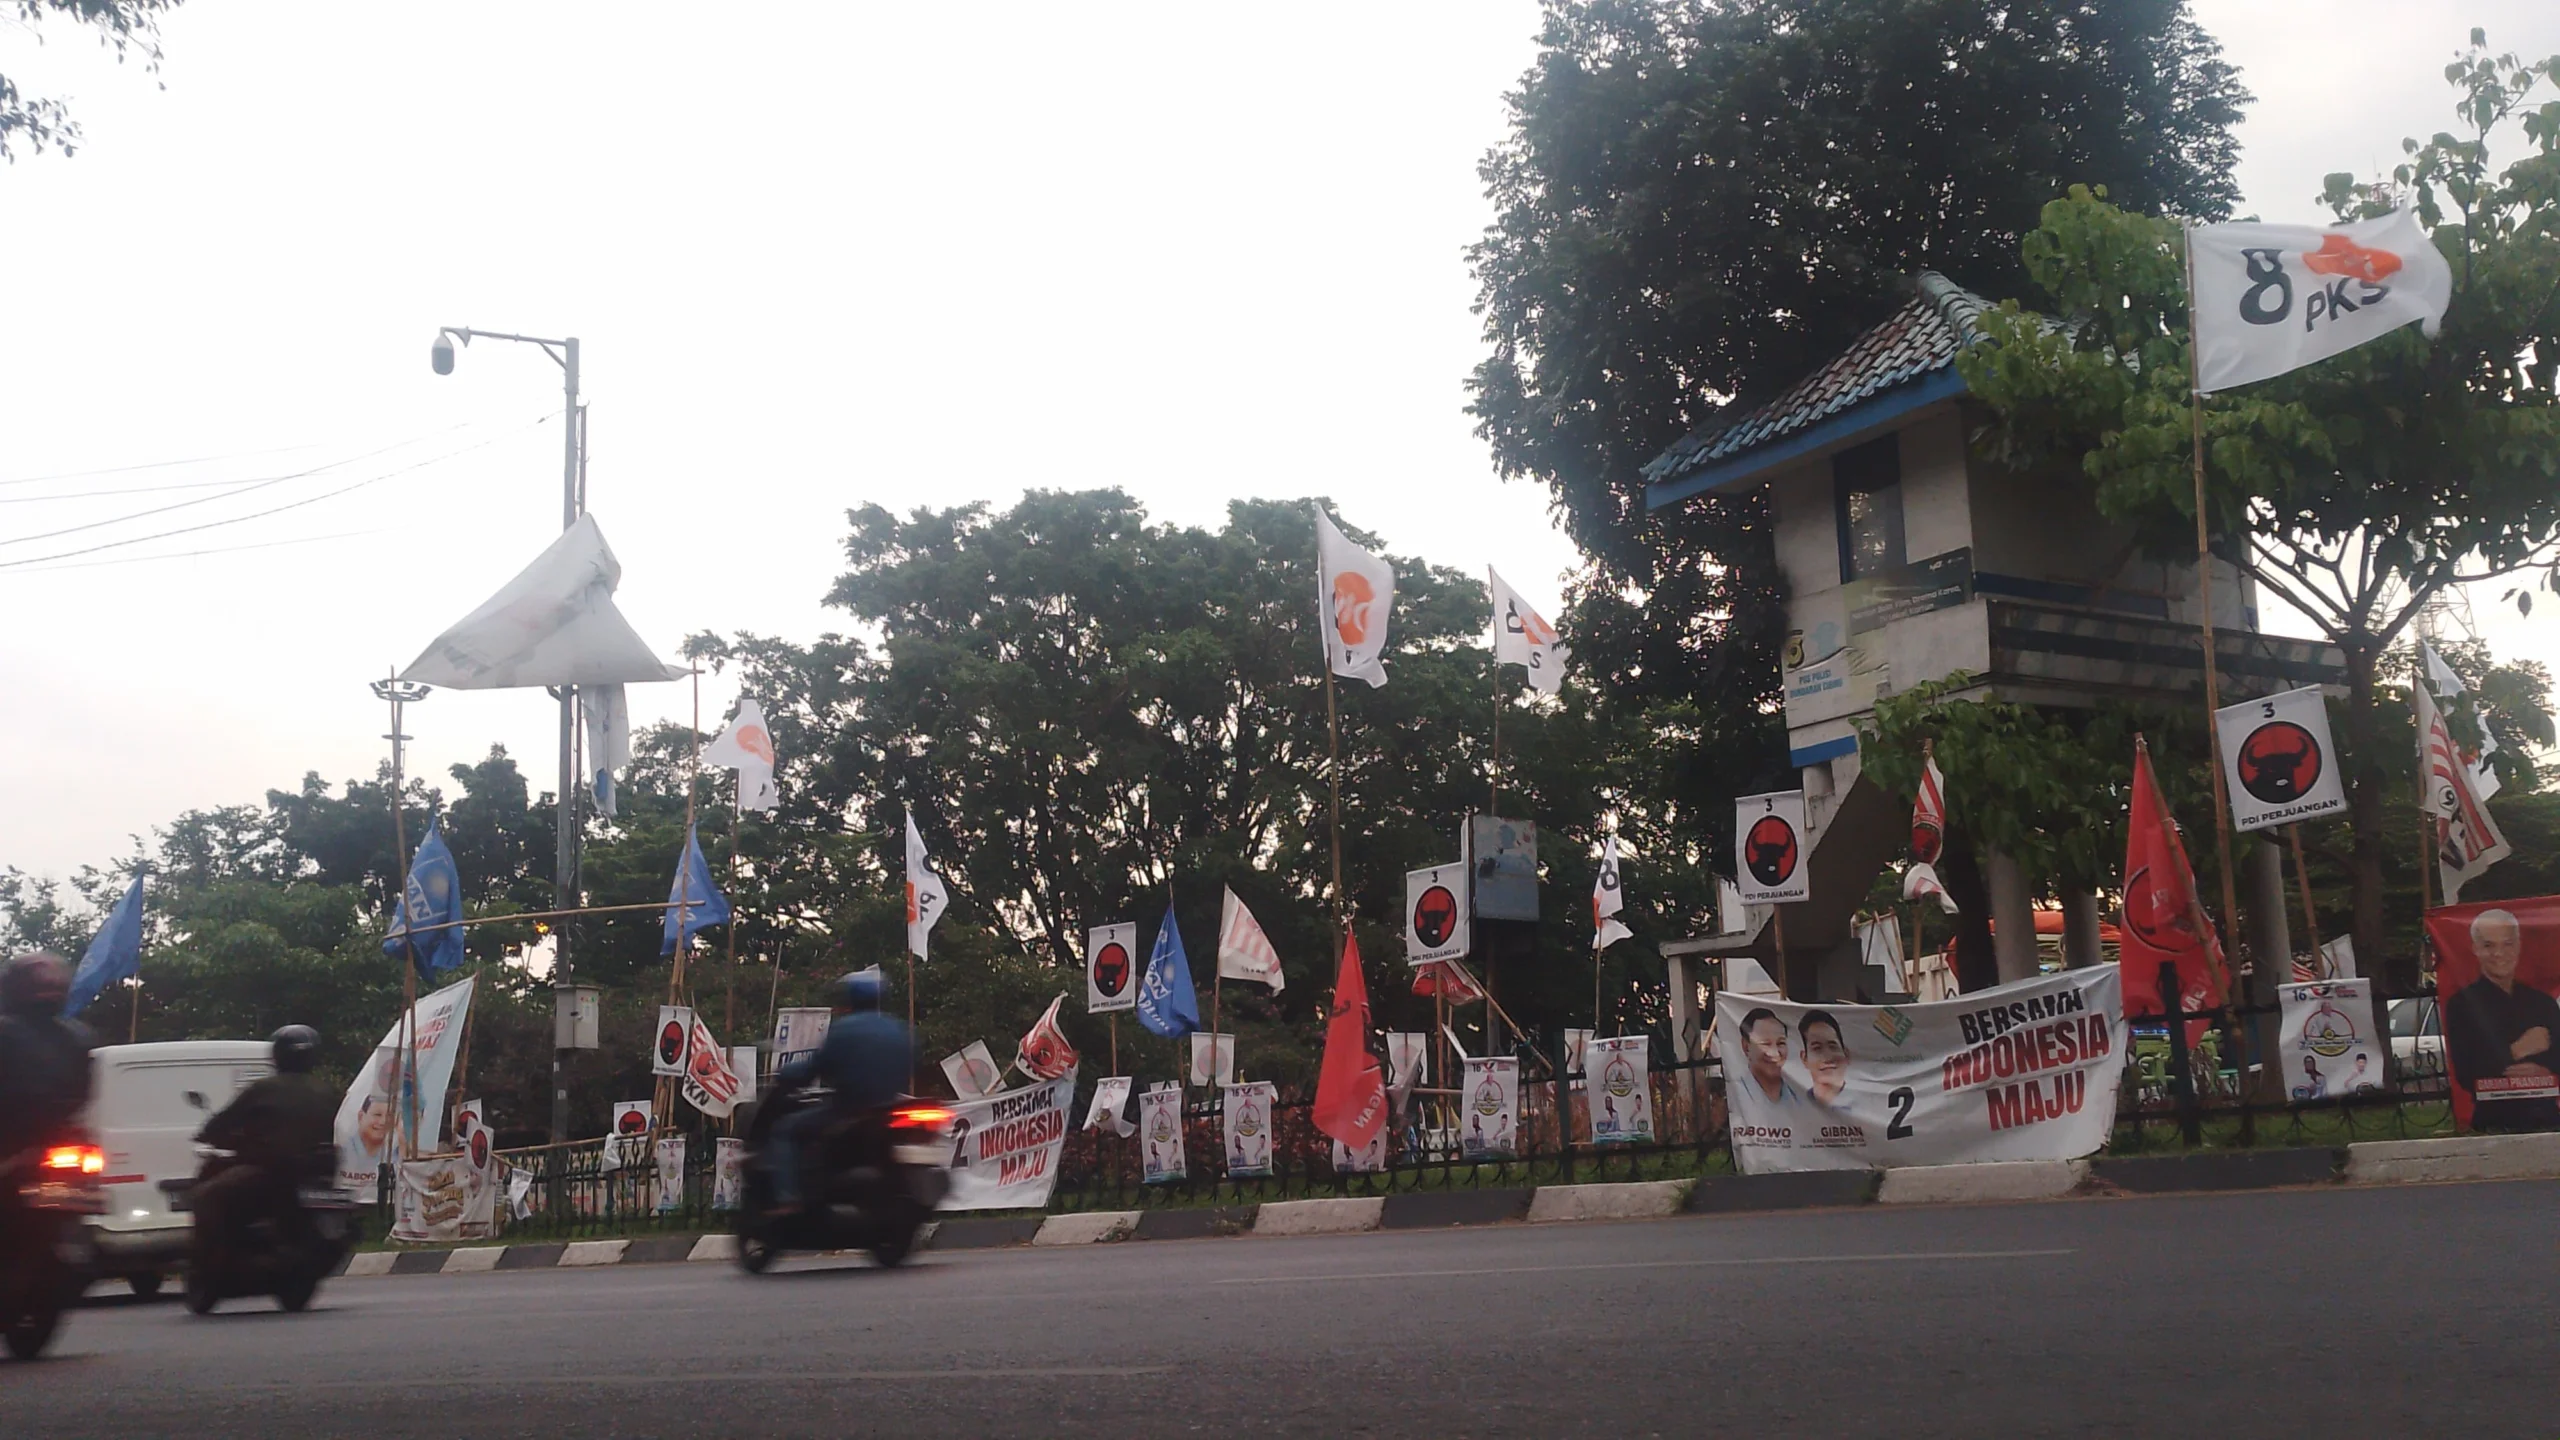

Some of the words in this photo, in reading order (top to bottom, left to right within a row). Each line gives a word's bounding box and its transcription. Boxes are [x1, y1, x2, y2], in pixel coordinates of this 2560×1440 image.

[2240, 248, 2292, 325] 8
[2262, 702, 2275, 718] 3
[1765, 798, 1773, 812] 3
[2242, 815, 2259, 826] PDI
[2262, 800, 2338, 821] PERJUANGAN
[1432, 871, 1438, 883] 3
[1600, 859, 1619, 891] 8
[1109, 929, 1116, 939] 3
[2292, 988, 2307, 1001] 16
[1942, 1013, 2110, 1091] INDONESIA
[1887, 1087, 1915, 1140] 2
[1986, 1070, 2085, 1131] MAJU
[950, 1118, 971, 1169] 2
[980, 1108, 1063, 1160] INDONESIA
[1733, 1126, 1791, 1138] PRABOWO
[1821, 1126, 1864, 1137] GIBRAN
[998, 1148, 1049, 1187] MAJU
